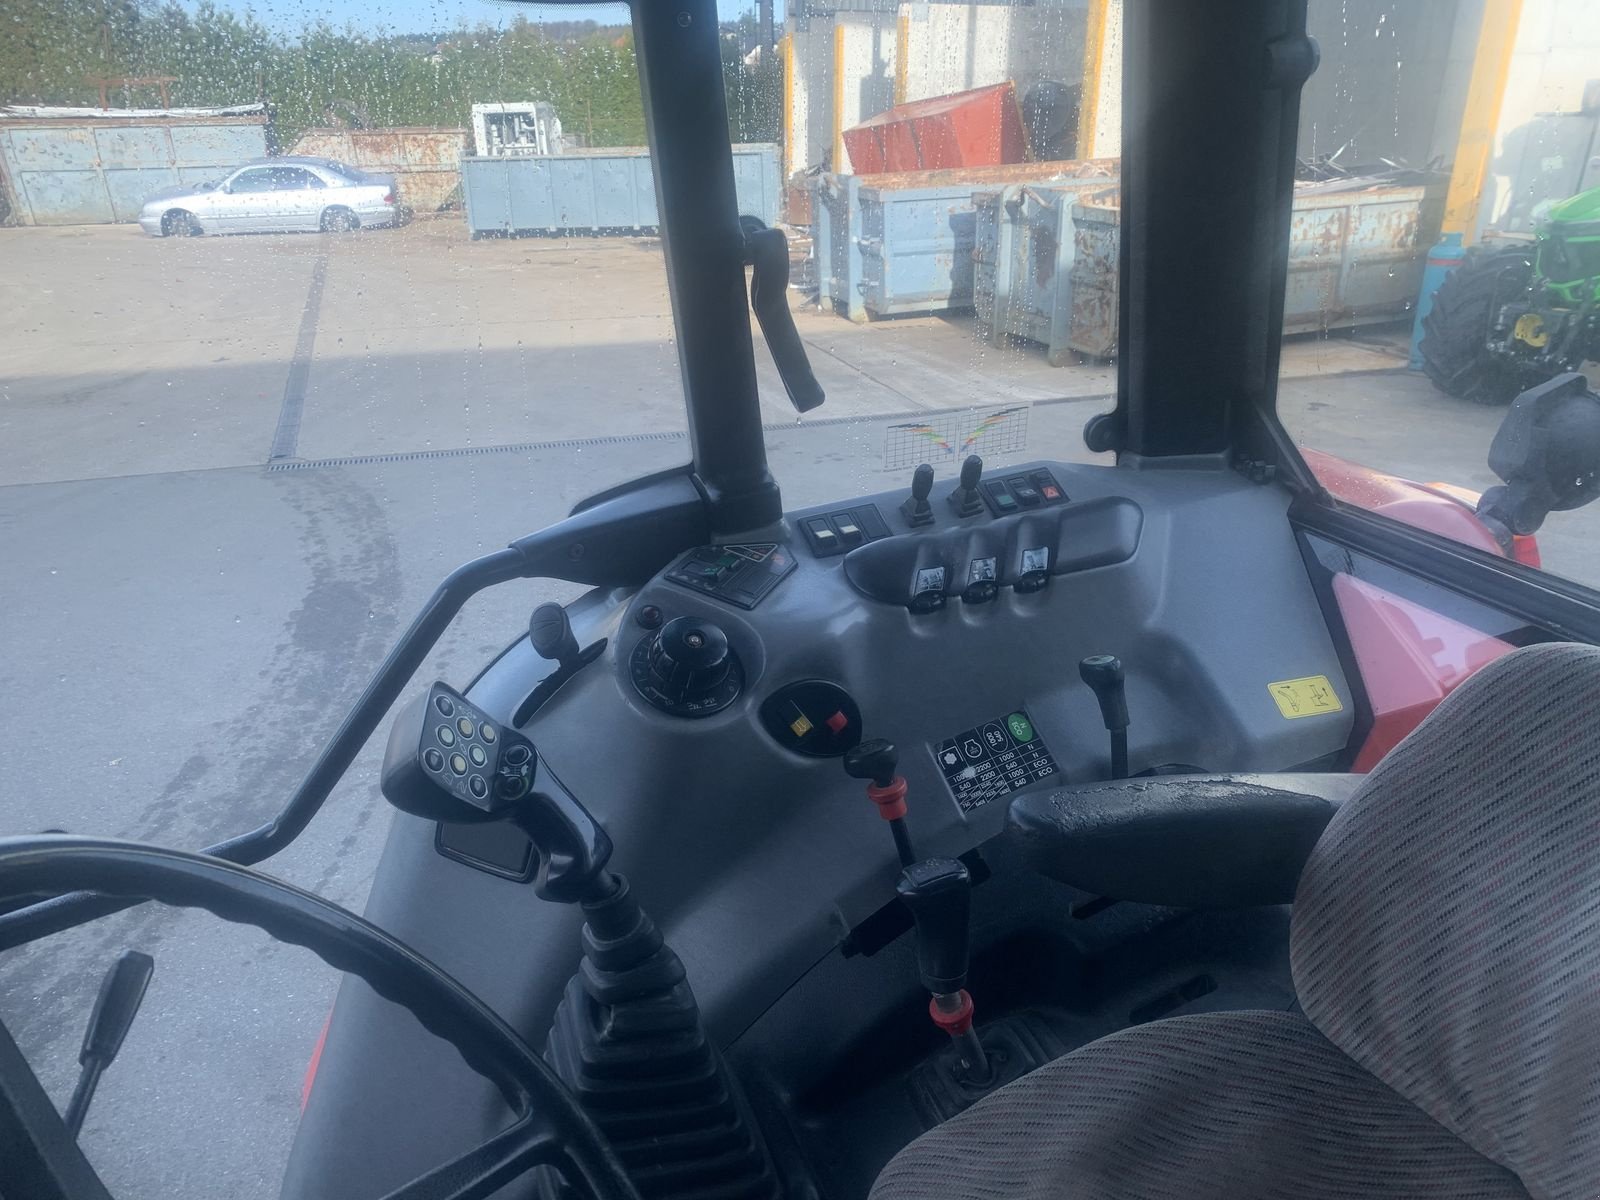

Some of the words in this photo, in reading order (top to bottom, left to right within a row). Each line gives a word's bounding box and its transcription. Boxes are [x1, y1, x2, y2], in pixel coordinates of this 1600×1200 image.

[993, 730, 1004, 742] 540
[1011, 721, 1023, 736] ECO
[986, 732, 998, 747] 1000
[952, 773, 966, 784] 100
[975, 762, 992, 773] 2200
[999, 752, 1015, 762] 1000
[959, 781, 971, 791] 540
[980, 770, 996, 781] 2200
[1006, 761, 1018, 770] 540
[1008, 768, 1024, 779] 1000
[1033, 758, 1048, 768] ECO
[1015, 778, 1027, 788] 540
[1038, 766, 1053, 777] ECO
